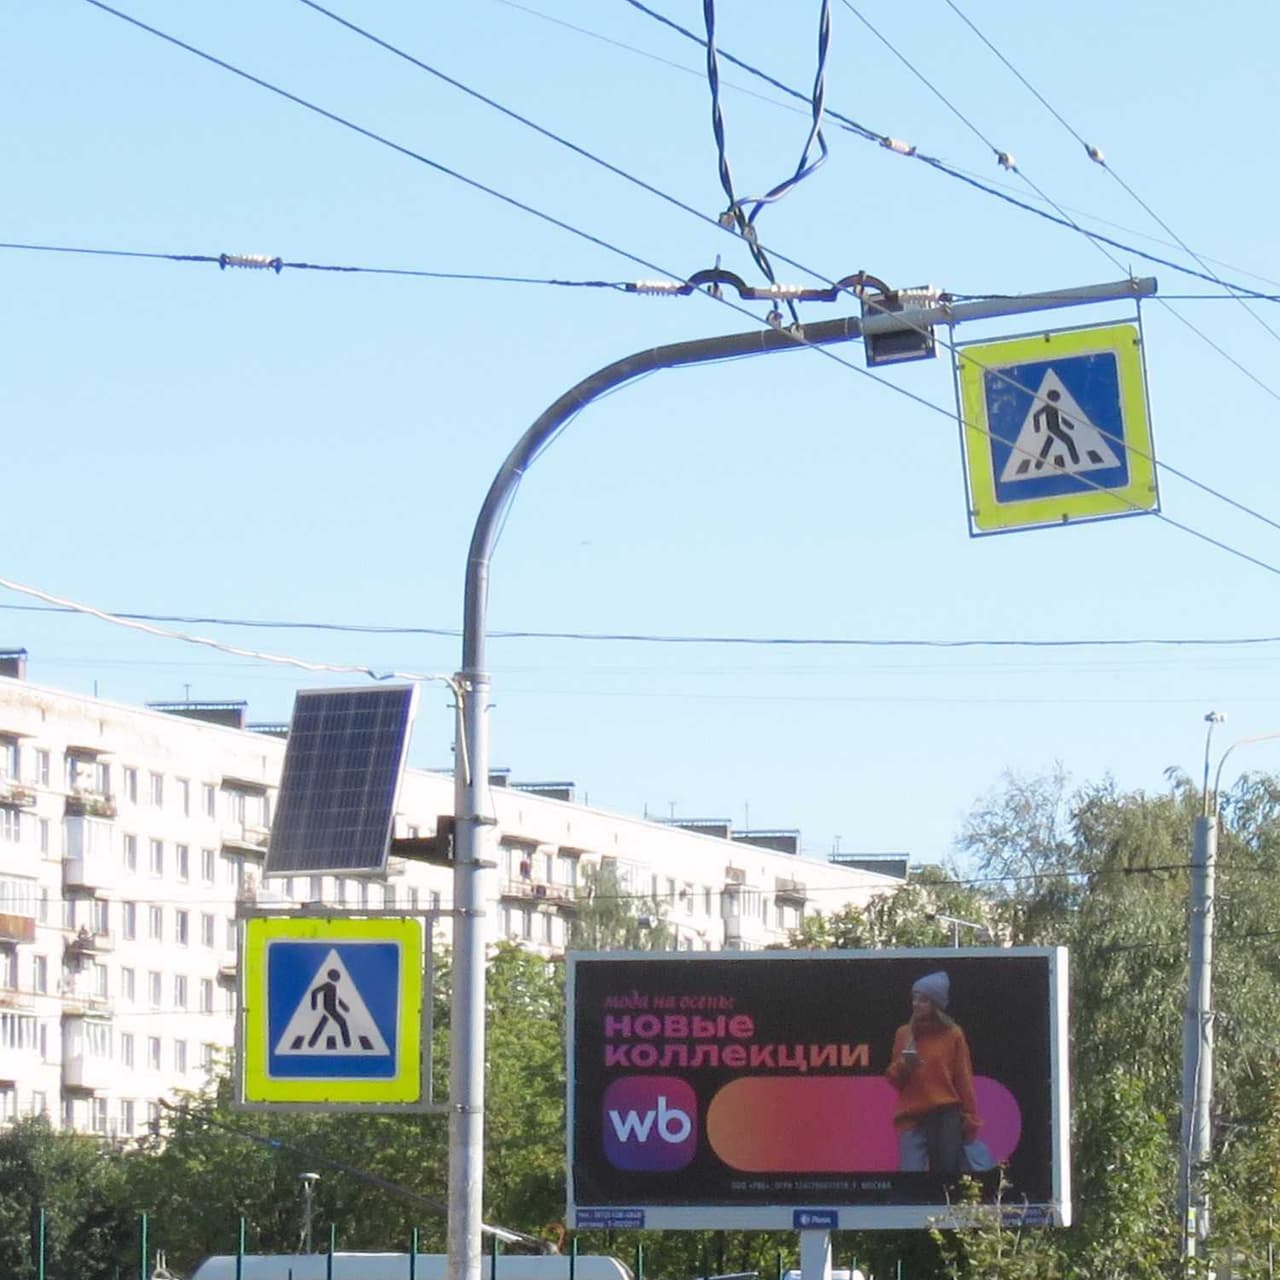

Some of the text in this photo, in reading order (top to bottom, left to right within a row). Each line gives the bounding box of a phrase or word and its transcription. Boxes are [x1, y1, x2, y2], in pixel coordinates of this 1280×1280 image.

[604, 1015, 755, 1038] новые
[604, 1044, 870, 1071] коллекции
[608, 1095, 692, 1144] wb
